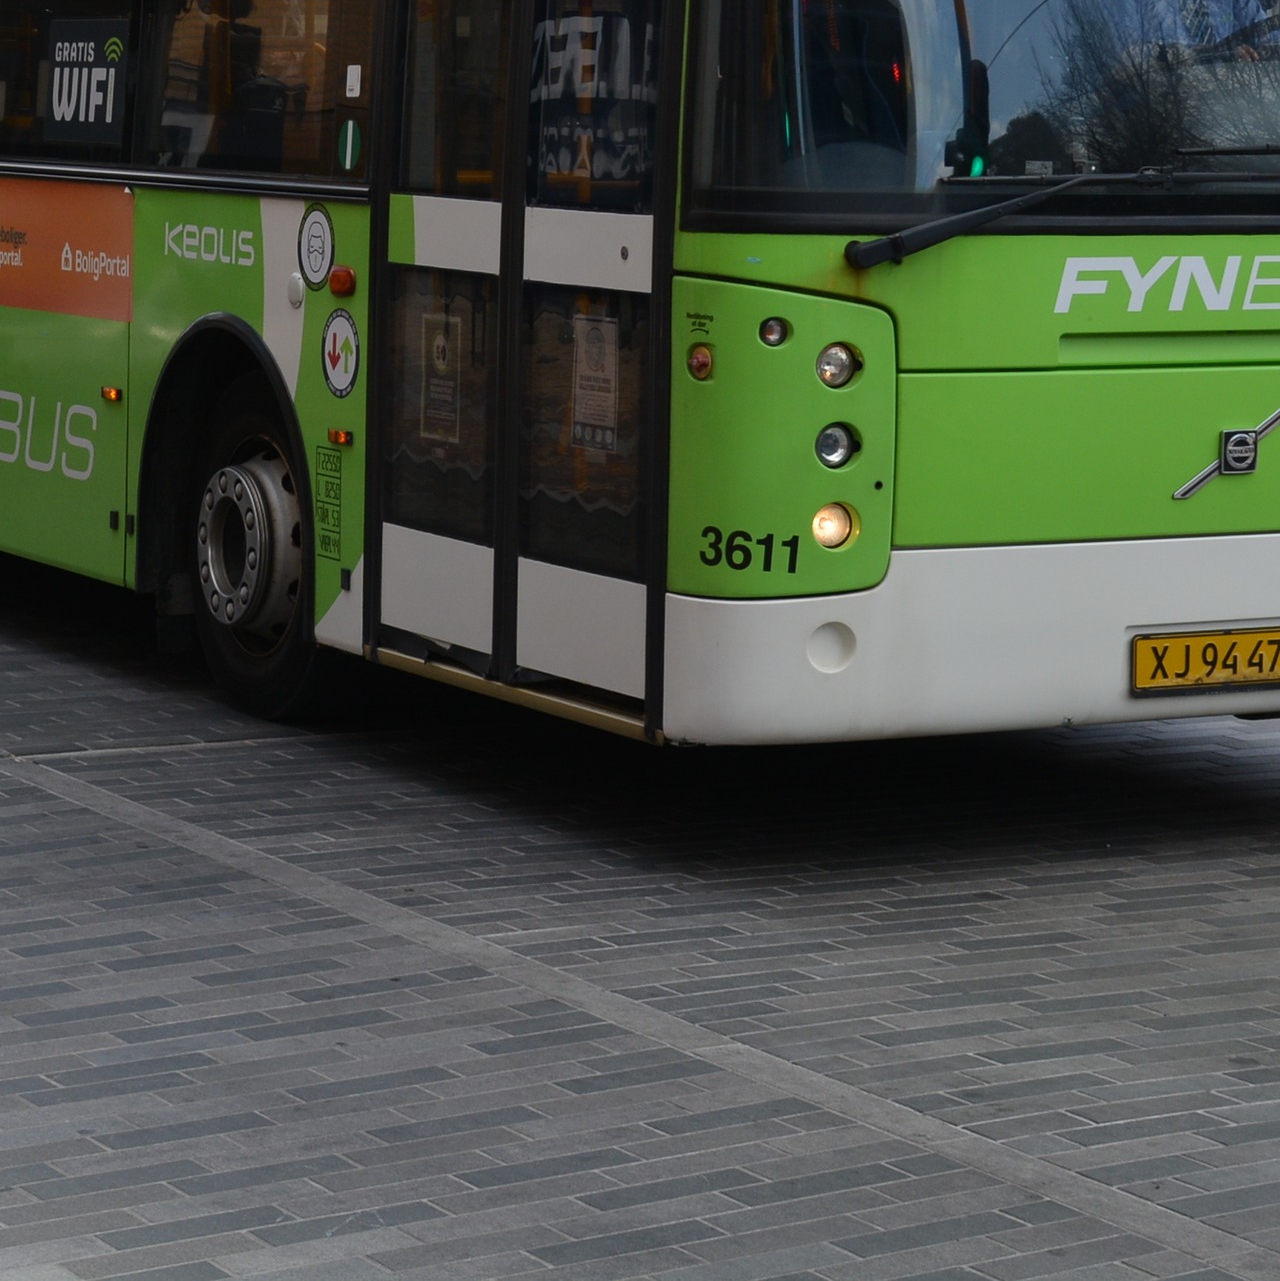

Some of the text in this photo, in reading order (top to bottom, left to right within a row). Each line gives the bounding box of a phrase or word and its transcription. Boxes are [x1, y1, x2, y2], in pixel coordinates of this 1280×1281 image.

[55, 42, 95, 62] GRATIS
[52, 67, 115, 123] WIFI
[75, 250, 130, 281] BoligPortal
[699, 526, 800, 574] 3611
[1150, 644, 1191, 680] XJ
[1201, 642, 1239, 678] 94
